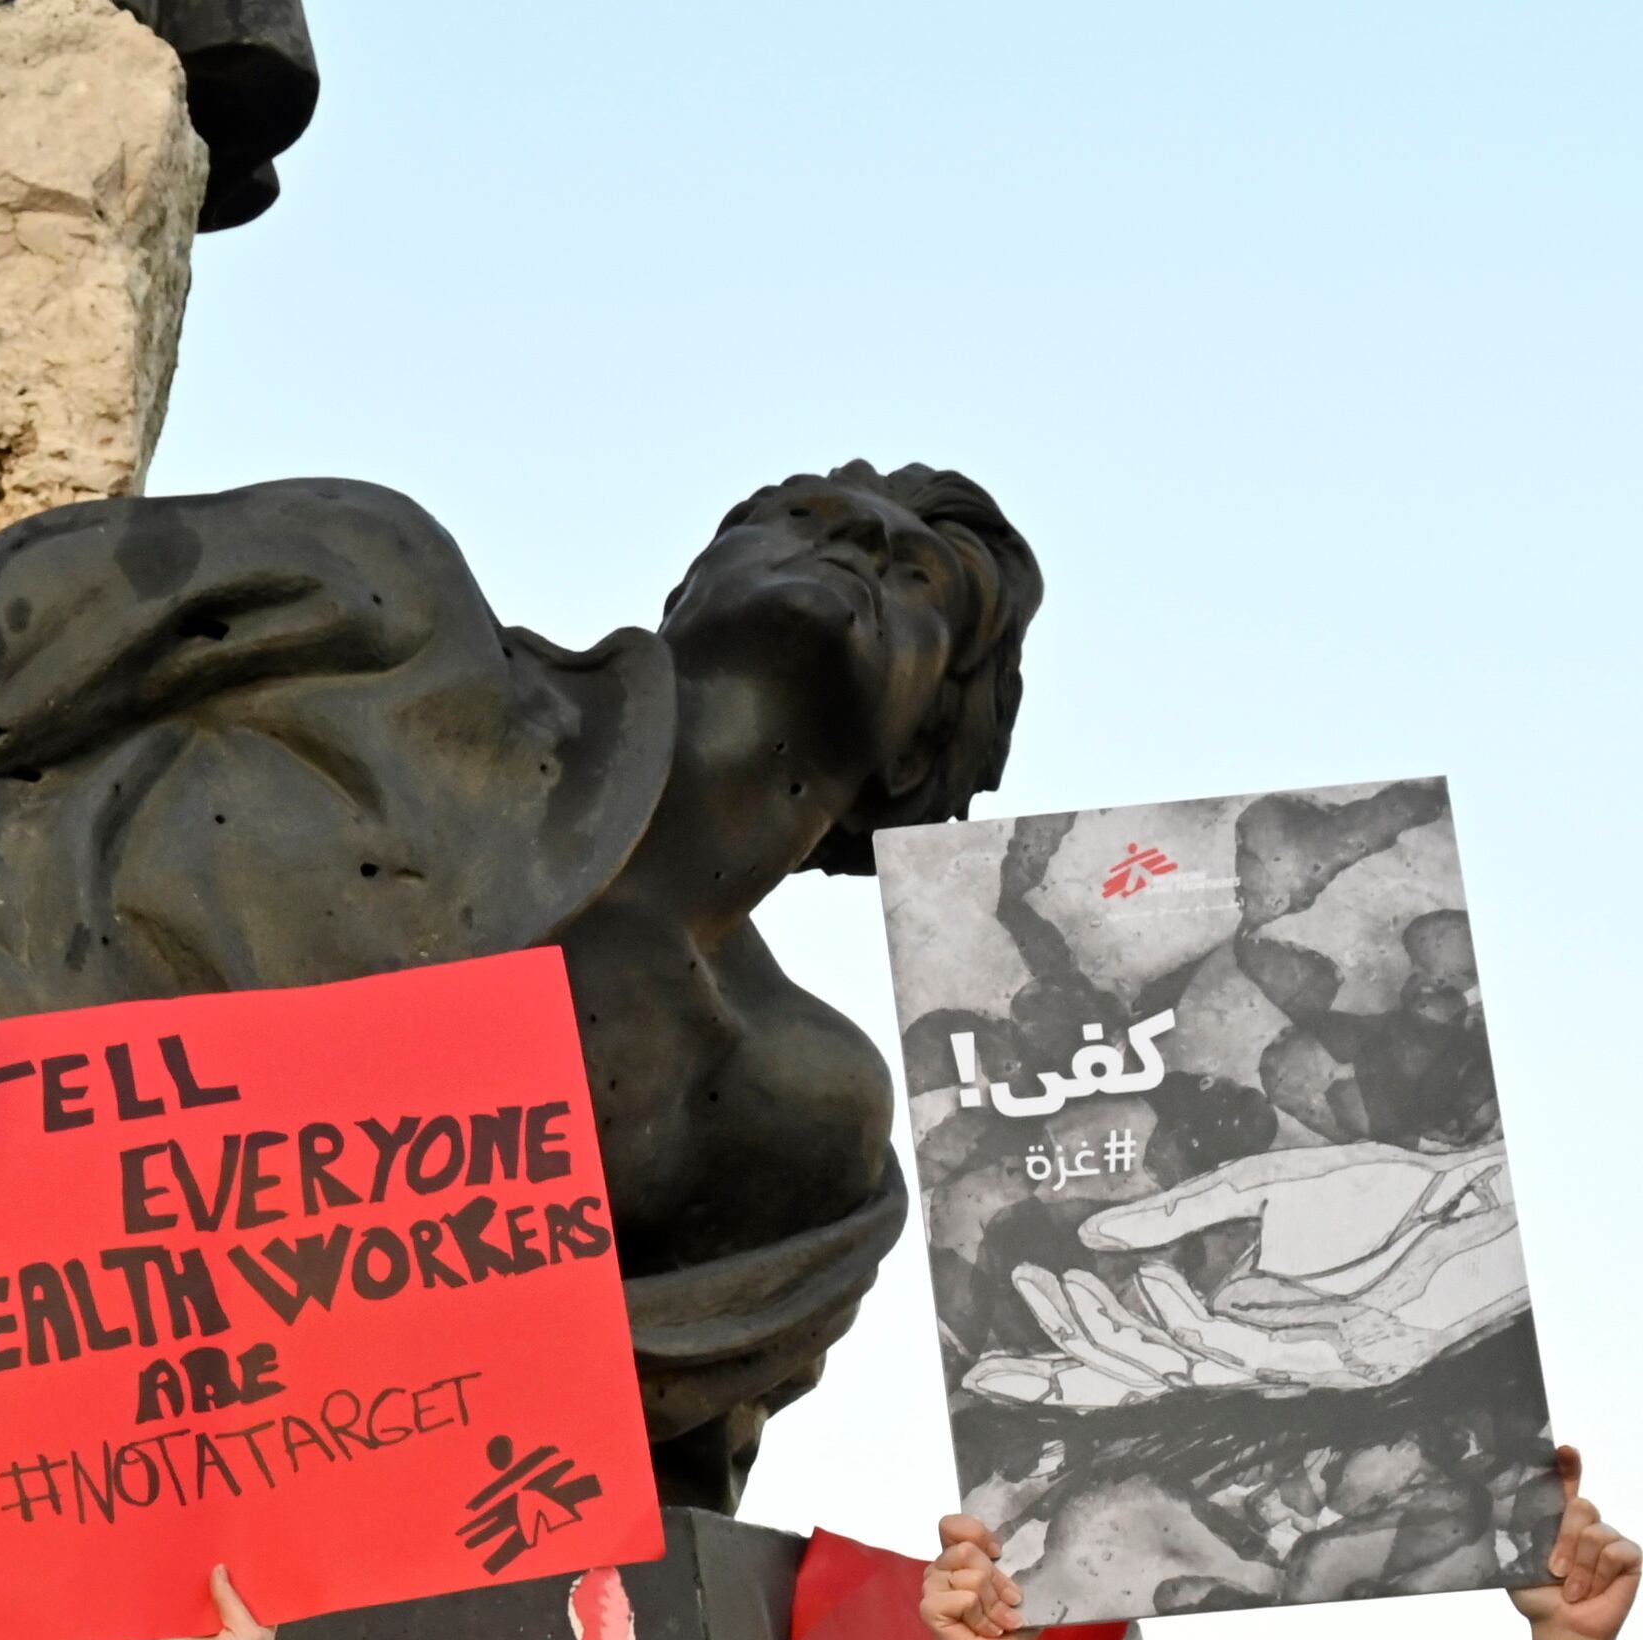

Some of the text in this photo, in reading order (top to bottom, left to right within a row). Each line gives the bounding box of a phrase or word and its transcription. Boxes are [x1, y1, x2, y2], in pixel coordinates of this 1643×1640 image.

[120, 1100, 572, 1235] EVERYONE
[1025, 1129, 1138, 1191] #غزة
[228, 1196, 612, 1326] WORKERS
[0, 1372, 482, 1525] #NOTATARGET
[135, 1343, 285, 1425] ARE
